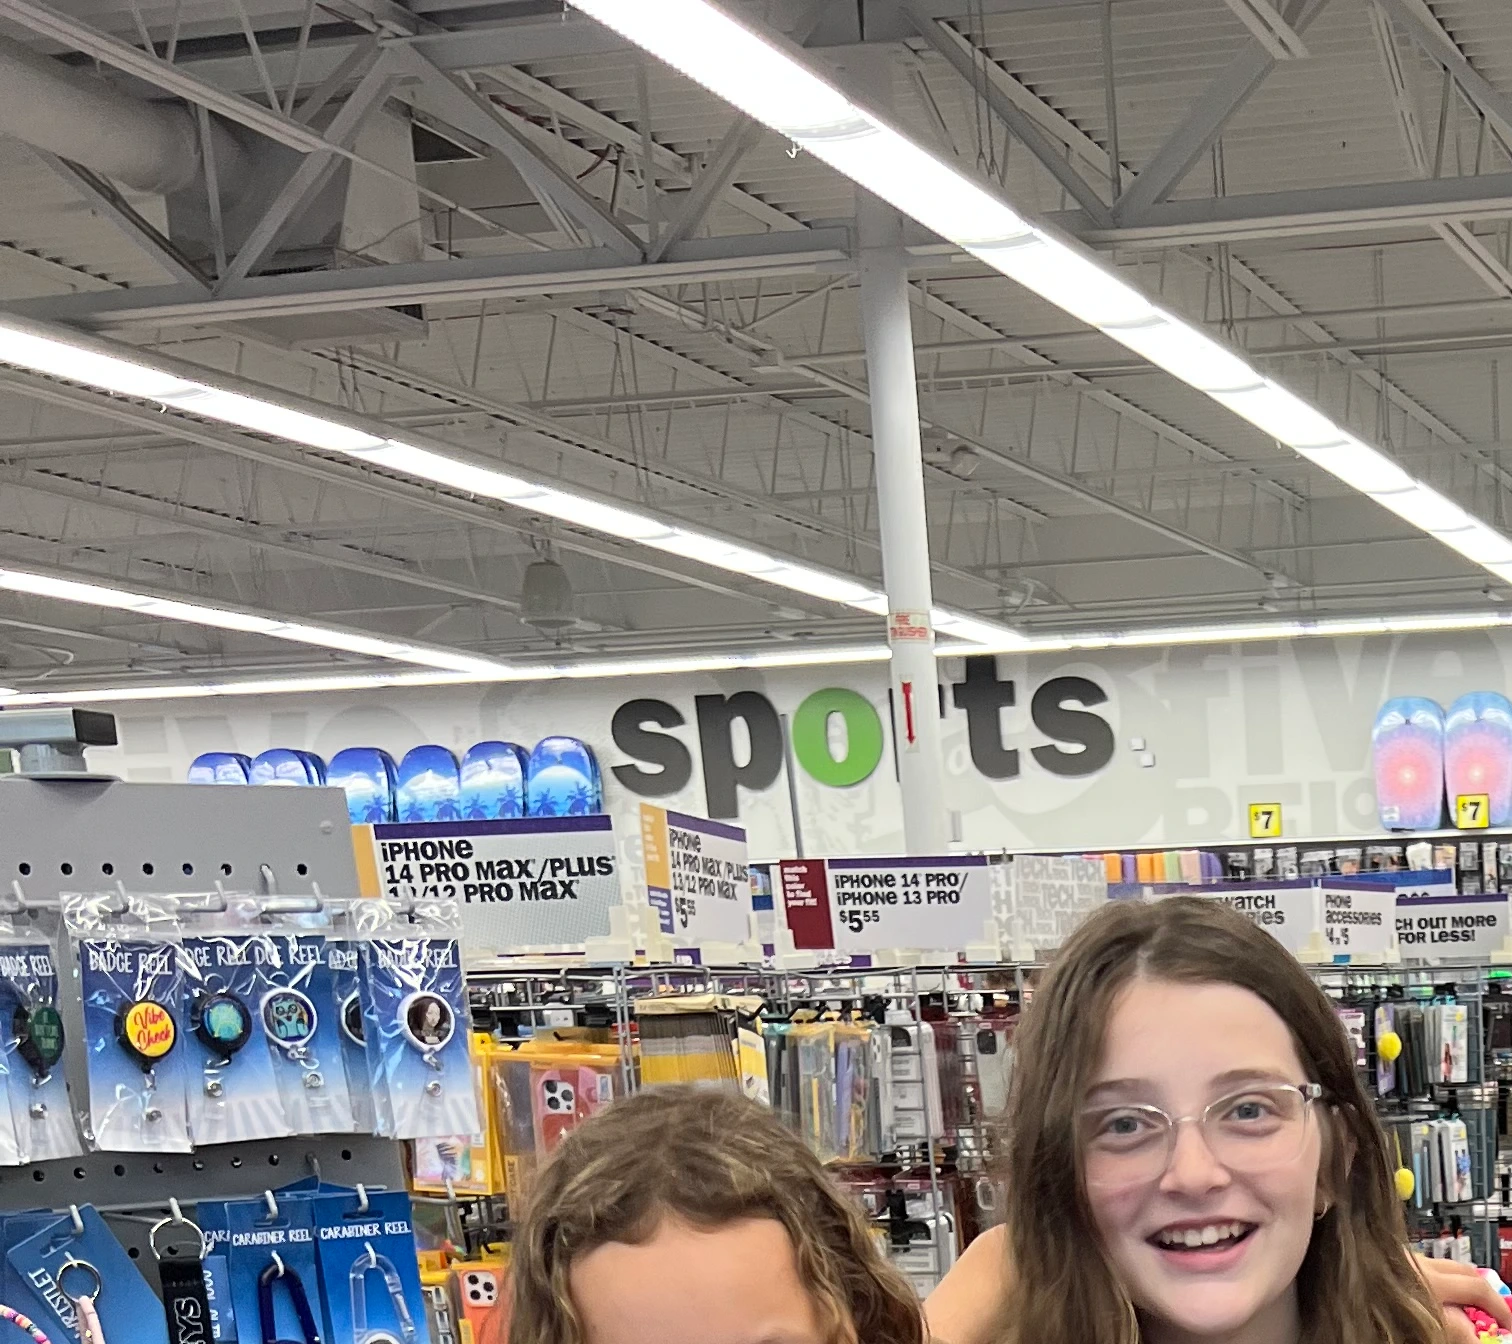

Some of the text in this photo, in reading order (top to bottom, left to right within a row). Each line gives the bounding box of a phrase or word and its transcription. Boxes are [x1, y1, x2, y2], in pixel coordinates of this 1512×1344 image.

[609, 656, 1115, 819] spots
[386, 864, 414, 885] 14
[421, 863, 470, 883] PRO
[902, 874, 922, 888] 14
[465, 881, 512, 903] PRO
[903, 890, 923, 905] 13
[926, 889, 961, 904] PRO
[1398, 931, 1427, 945] FOR
[88, 949, 135, 975] BADGE
[133, 1005, 166, 1029] Vibe
[383, 1220, 413, 1235] REEL
